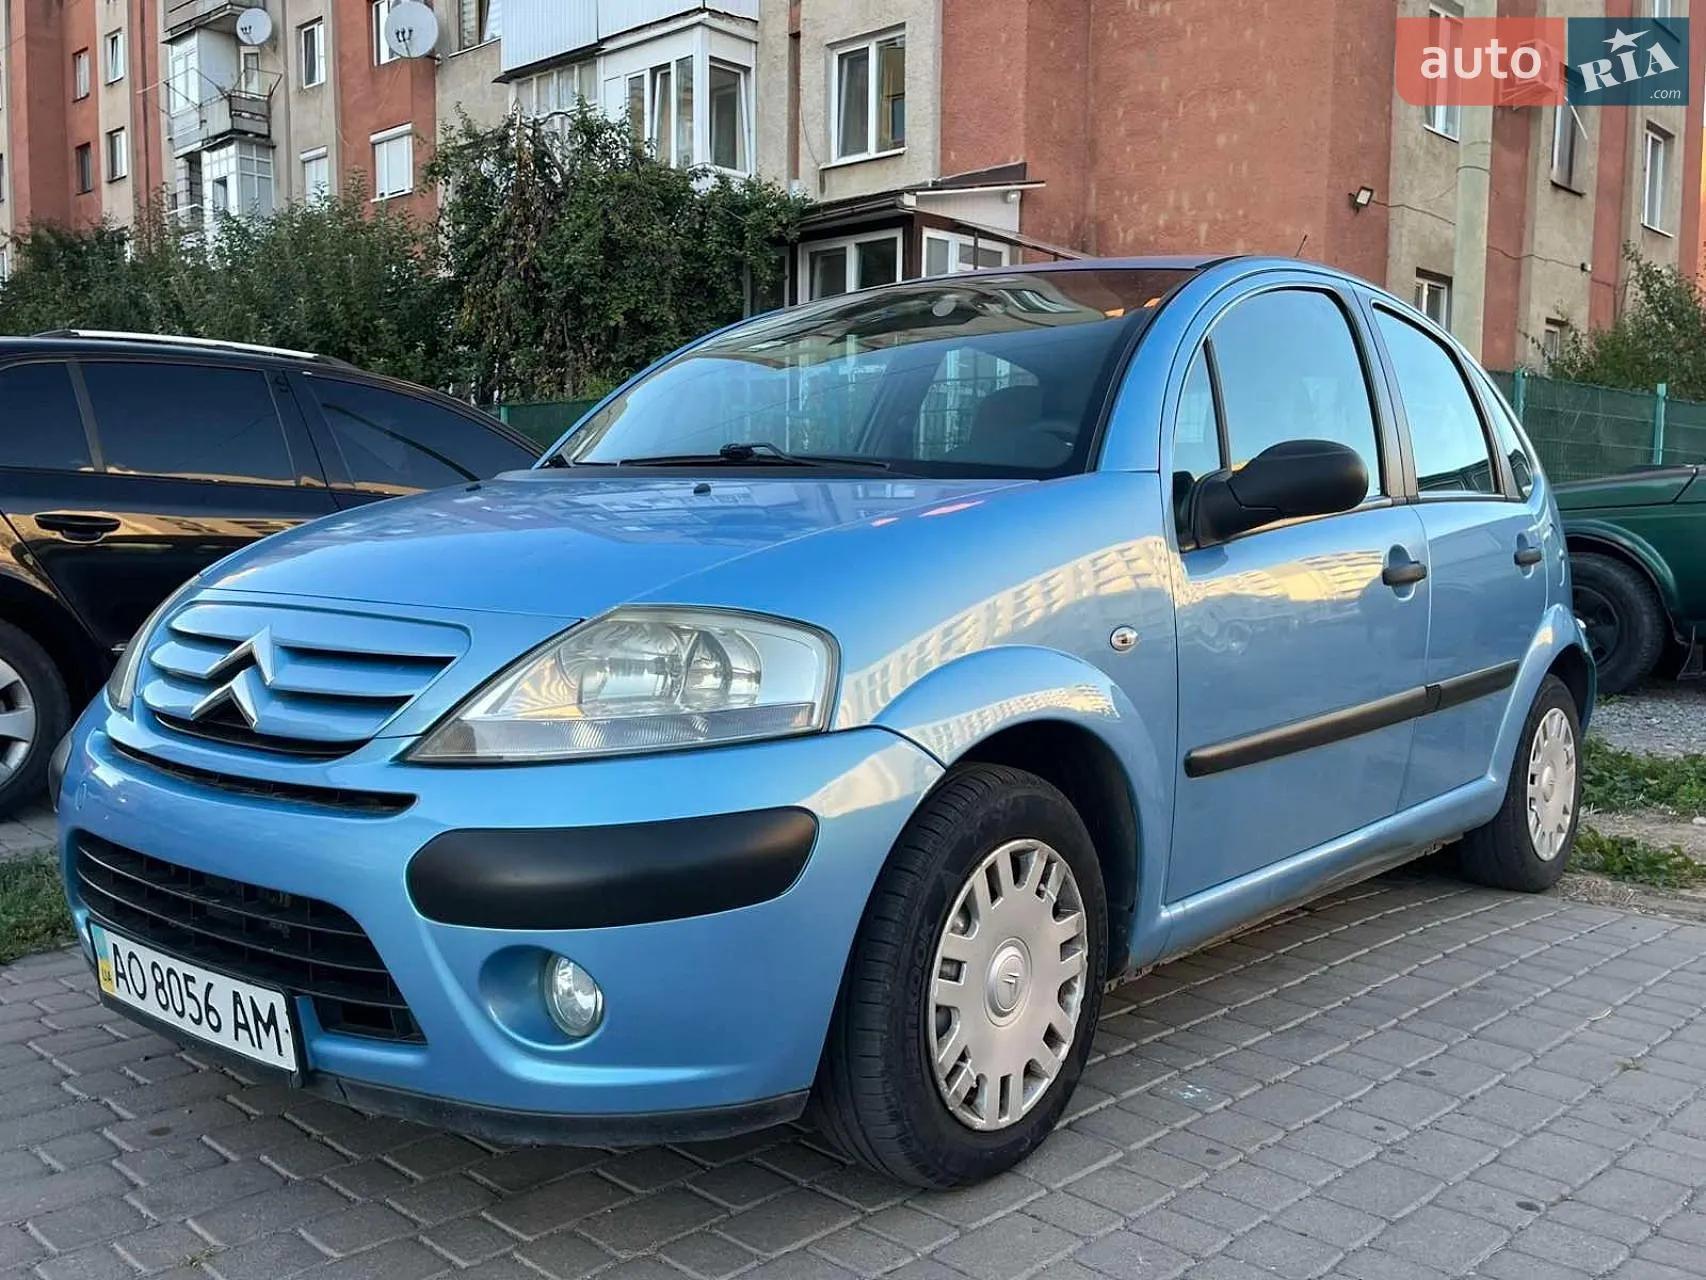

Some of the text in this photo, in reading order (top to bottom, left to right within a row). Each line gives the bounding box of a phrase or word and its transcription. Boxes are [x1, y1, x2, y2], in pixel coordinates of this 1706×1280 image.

[112, 942, 284, 1057] AO 8056 AM
